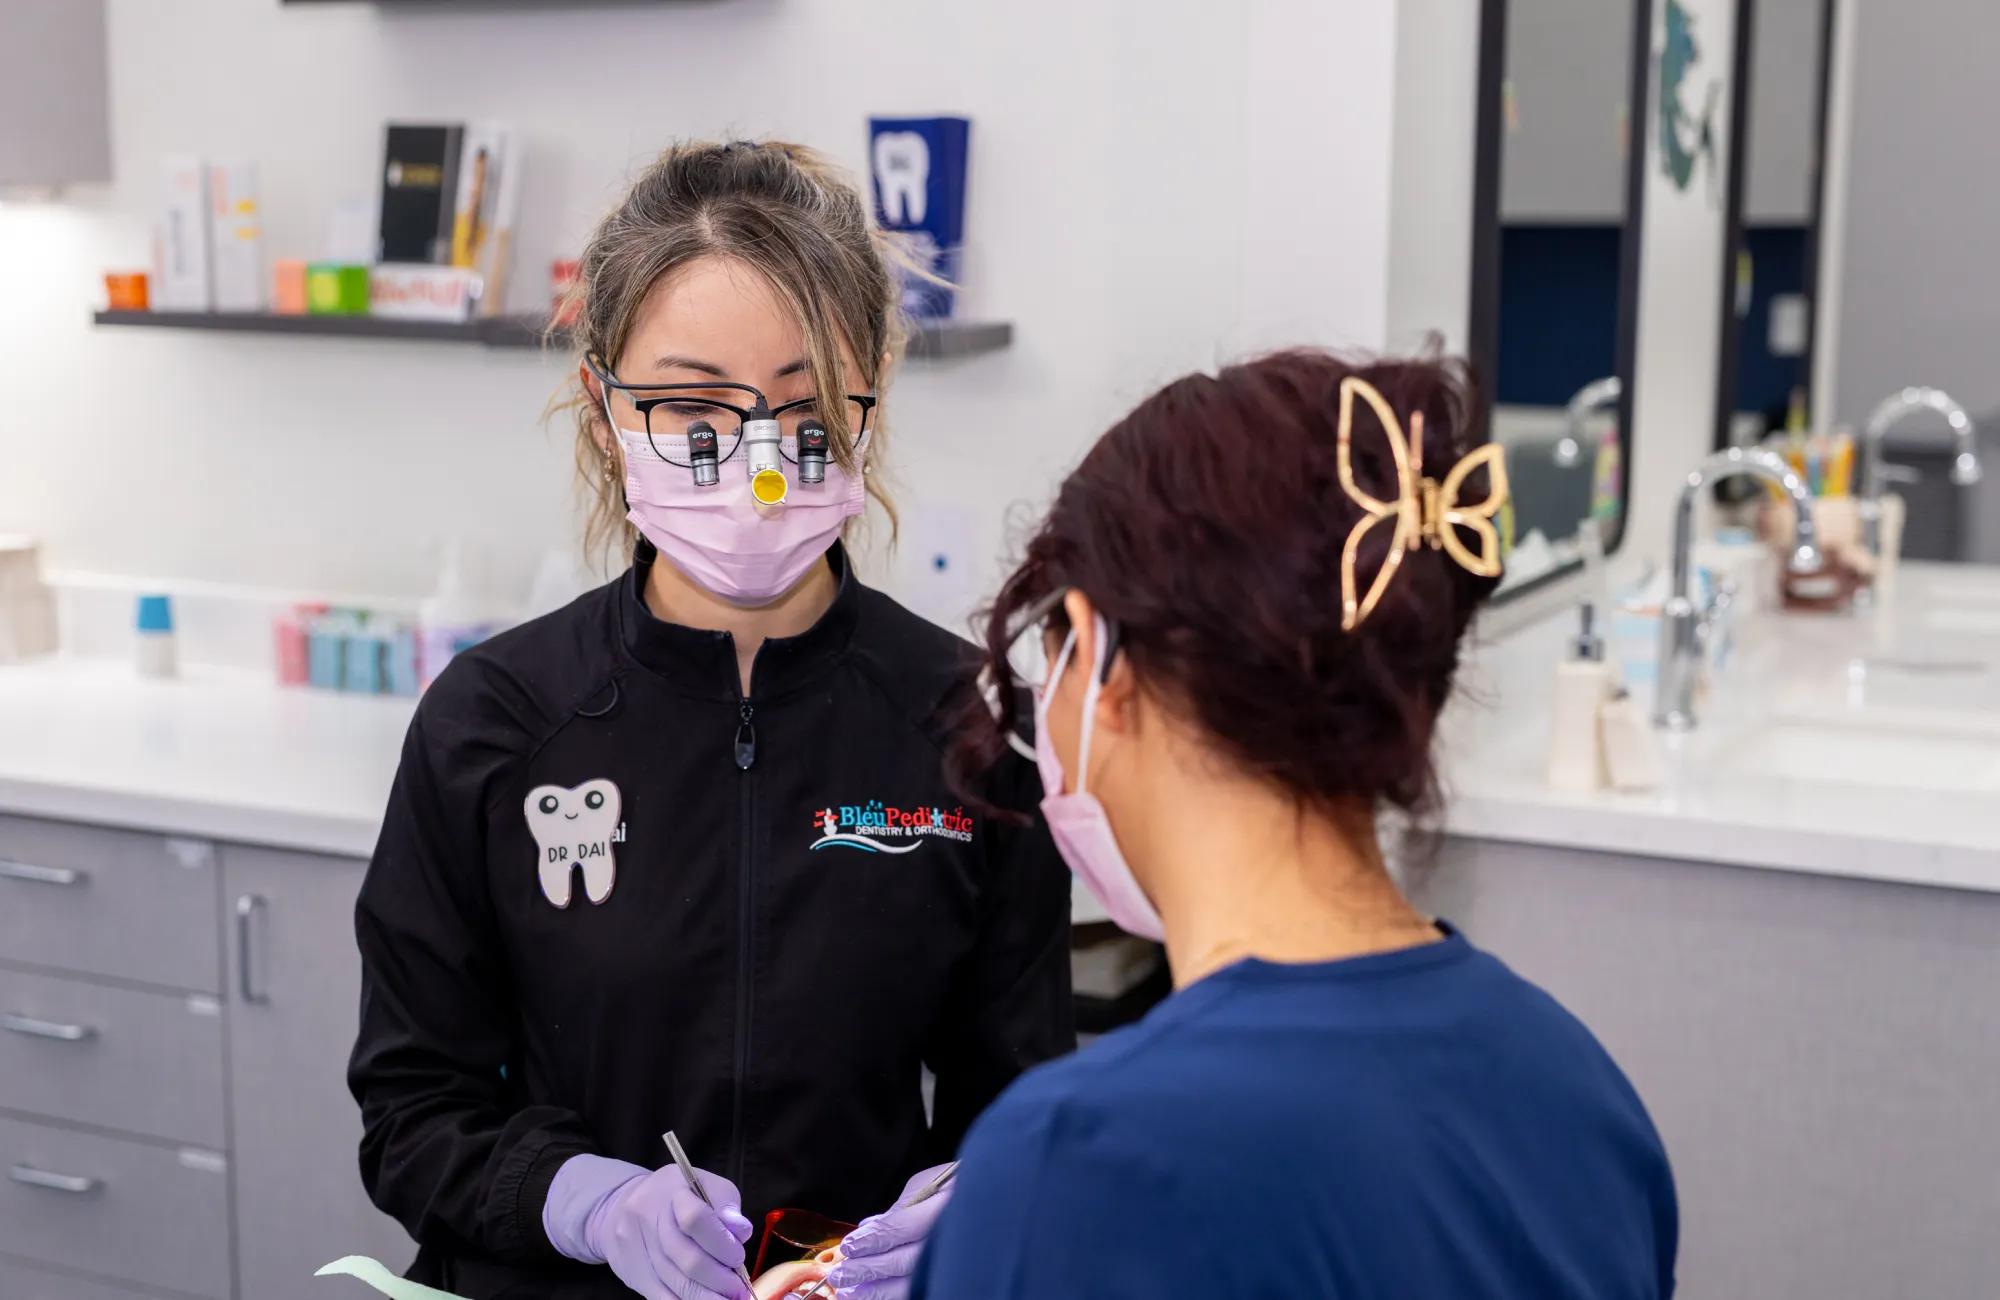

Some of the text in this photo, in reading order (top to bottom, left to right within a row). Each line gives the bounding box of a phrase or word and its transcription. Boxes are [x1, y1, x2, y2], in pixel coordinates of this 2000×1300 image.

[692, 431, 713, 439] ergo
[804, 428, 825, 436] ergo
[855, 826, 904, 836] DENTISTRY
[905, 826, 912, 836] &
[548, 841, 605, 863] DR DAI
